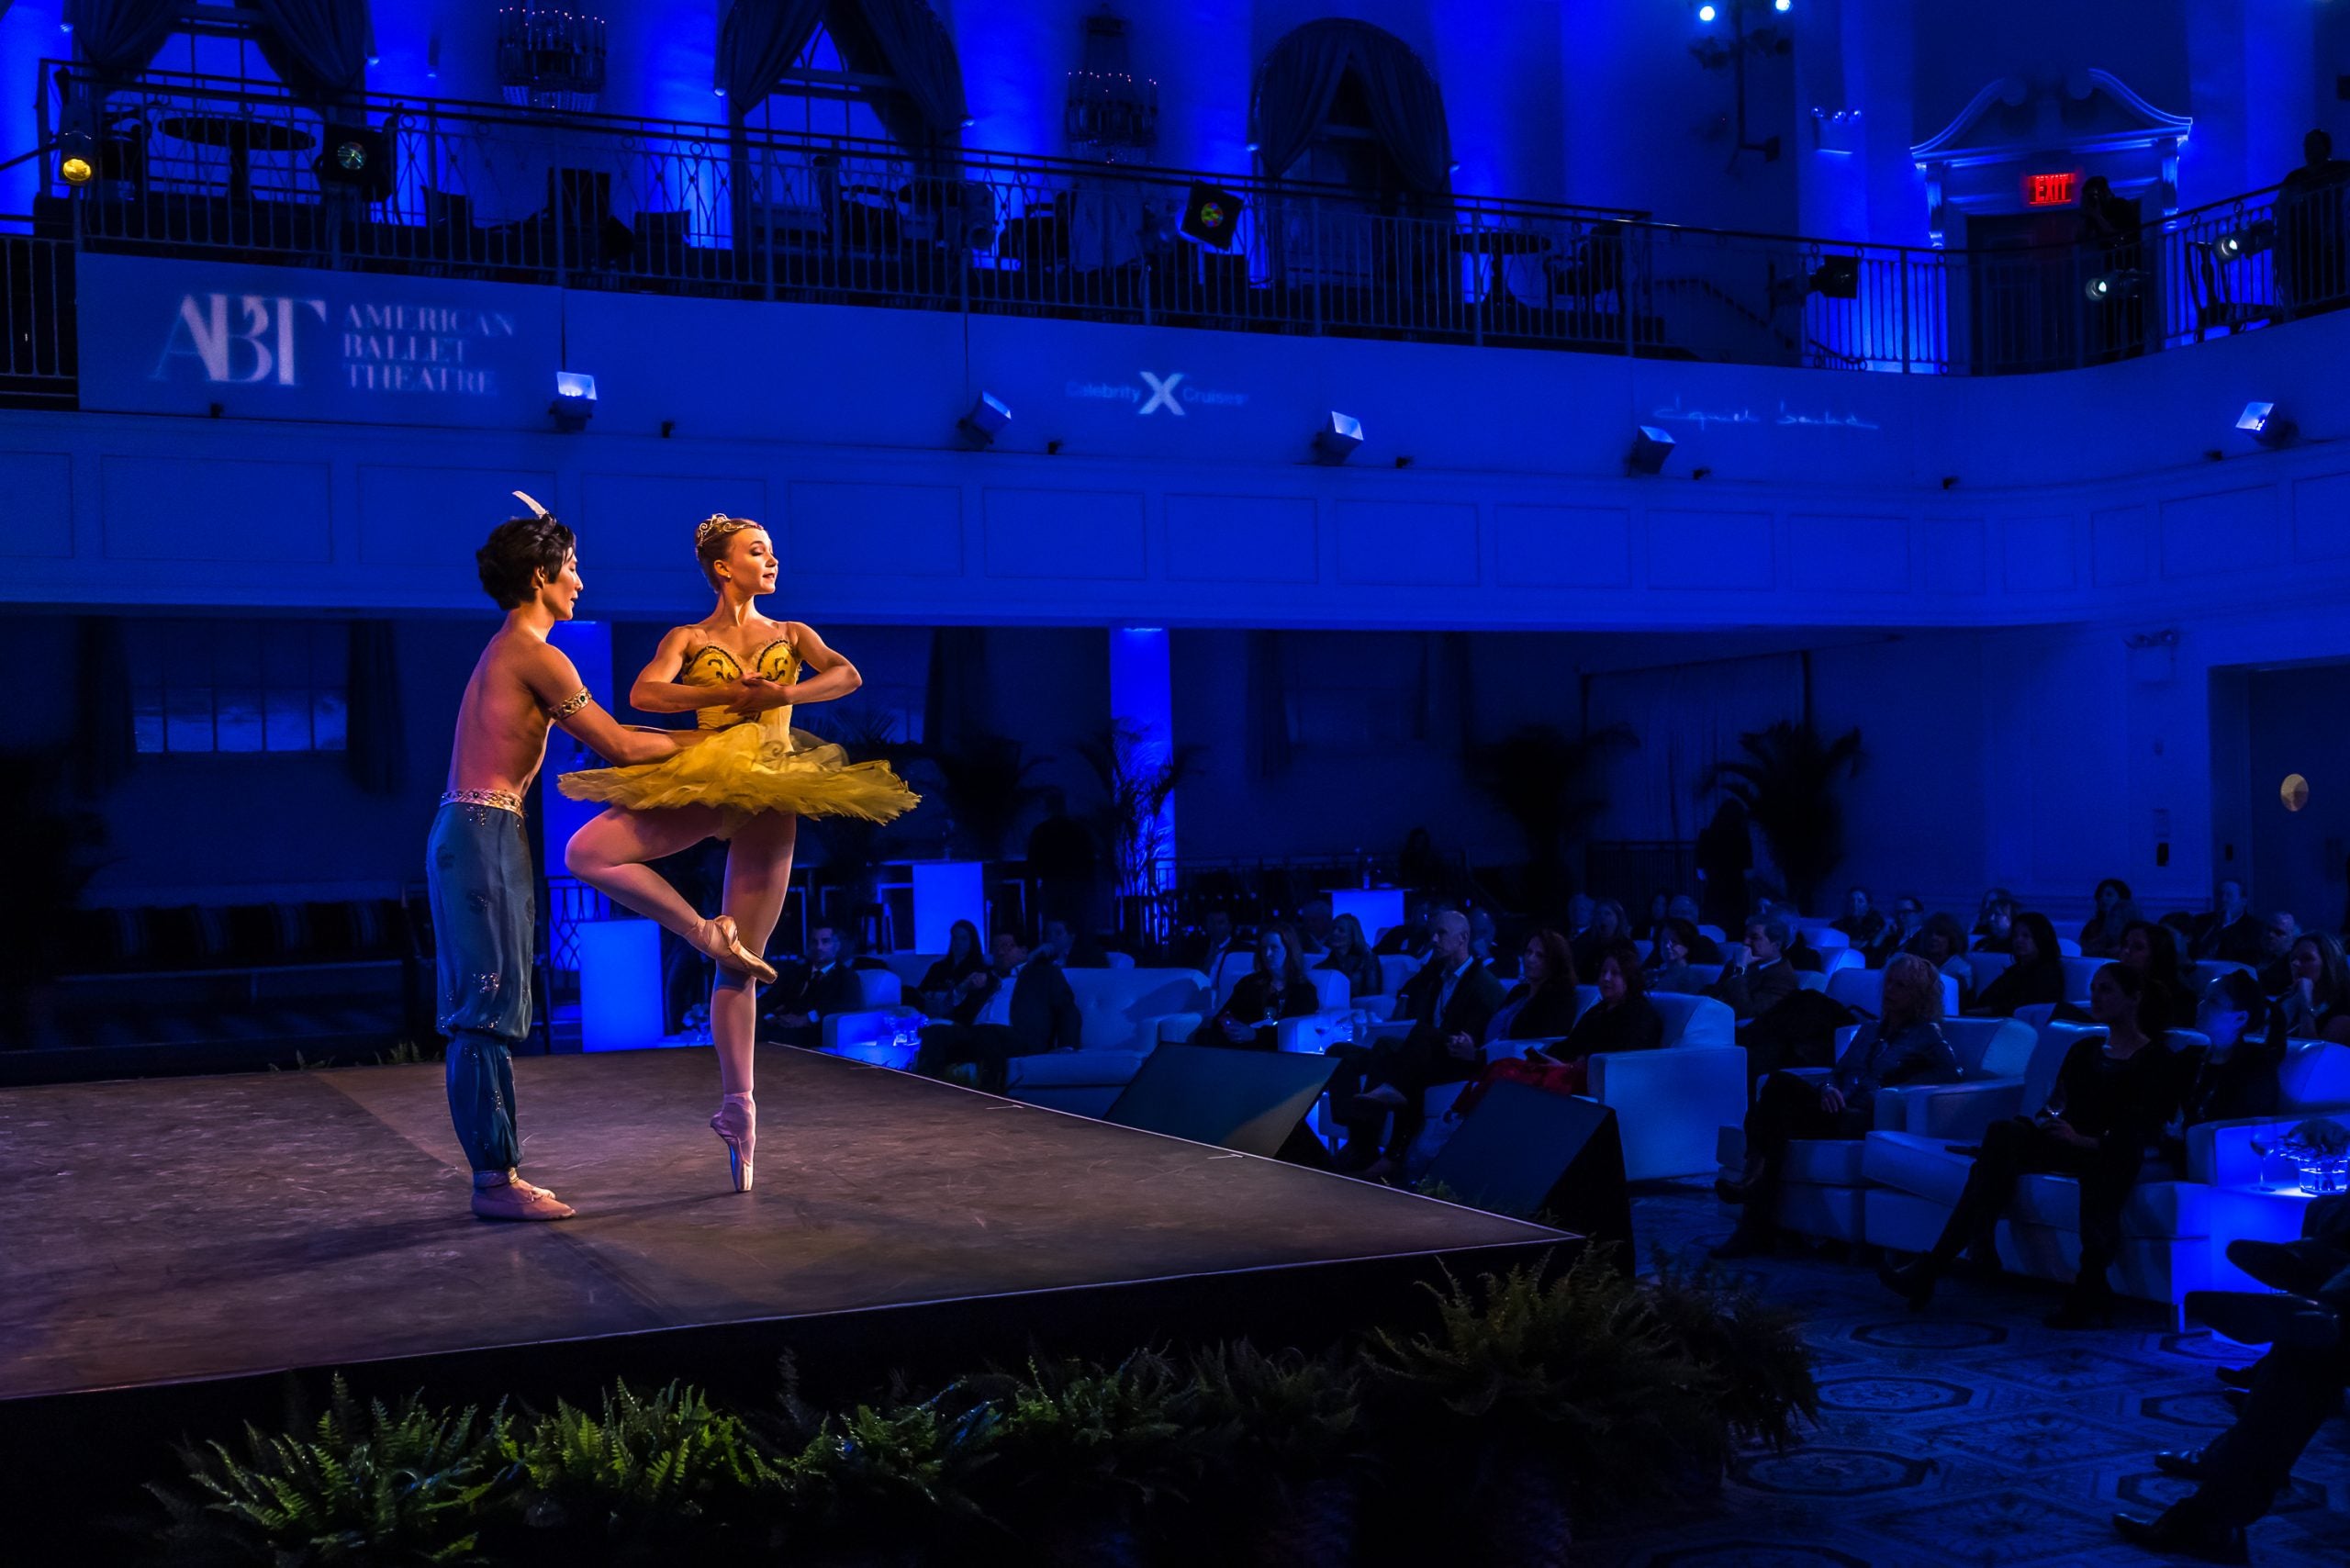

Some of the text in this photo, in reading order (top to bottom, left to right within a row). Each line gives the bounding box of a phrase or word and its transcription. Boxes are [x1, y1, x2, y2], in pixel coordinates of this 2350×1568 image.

[2034, 174, 2069, 202] EXIT
[343, 304, 516, 337] AMERICAN
[148, 293, 327, 386] ABT
[342, 332, 469, 364] BALLET
[343, 364, 498, 396] THEATRE
